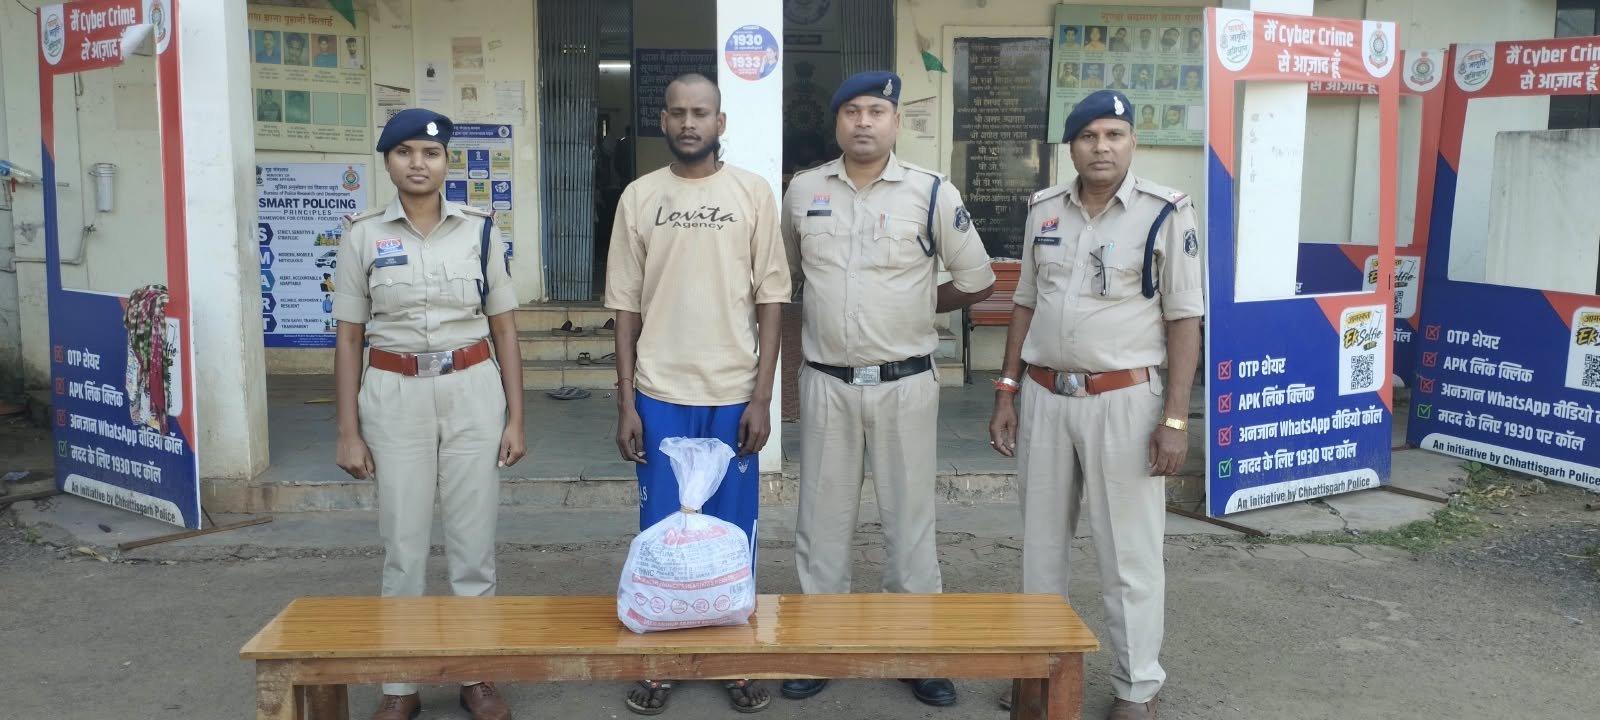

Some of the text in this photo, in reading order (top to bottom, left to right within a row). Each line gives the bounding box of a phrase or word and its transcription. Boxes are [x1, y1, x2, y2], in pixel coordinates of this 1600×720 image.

[70, 5, 136, 33] मैं Cyber Crime
[732, 34, 763, 46] 1930
[1264, 20, 1354, 47] मैं Cyber Crime
[81, 37, 90, 61] से
[92, 38, 119, 62] आज़ाद
[732, 56, 761, 68] 1933
[1506, 43, 1600, 67] मैं Cyber Crim
[1278, 49, 1342, 78] से आज़ाद हूँ
[1520, 63, 1599, 92] से आज़ाद हूँ
[258, 197, 356, 209] SMART POLICING
[655, 206, 738, 226] Lovita
[259, 227, 268, 239] S
[672, 221, 724, 230] Agency
[165, 341, 177, 357] lfie
[1343, 328, 1359, 349] Ek
[1357, 327, 1382, 346] Selfie
[1447, 329, 1501, 350] OTP शेयर
[1576, 327, 1598, 345] Ek
[67, 347, 100, 370] OTP शेयर
[1238, 355, 1286, 378] OTP शेयर
[1443, 356, 1534, 383] APK लिंक क्लिक
[69, 380, 124, 407] APK लिंक क्लिक
[1238, 383, 1316, 411] APK लिंक क्लिक
[1441, 383, 1485, 403] अनजान
[1487, 390, 1551, 418] WhatsApp
[1553, 400, 1594, 424] वीडियो
[70, 413, 97, 435] अनजान
[98, 419, 137, 447] WhatsApp
[164, 432, 183, 455] कॉल
[1238, 405, 1383, 443] अनजान WhatsApp वीडियो कॉल
[1438, 409, 1586, 451] मदद के लिए 1930 पर कॉल
[71, 445, 162, 483] मदद के लिए 1930 पर कॉल
[1238, 439, 1357, 475] मदद के लिए 1930 पर कॉल
[1433, 439, 1600, 487] An initiative by Chhattisgarh Police
[71, 481, 176, 523] An initiative by Chhattisgarh Police
[1237, 476, 1371, 510] An initiative by Chhattisgarh Police
